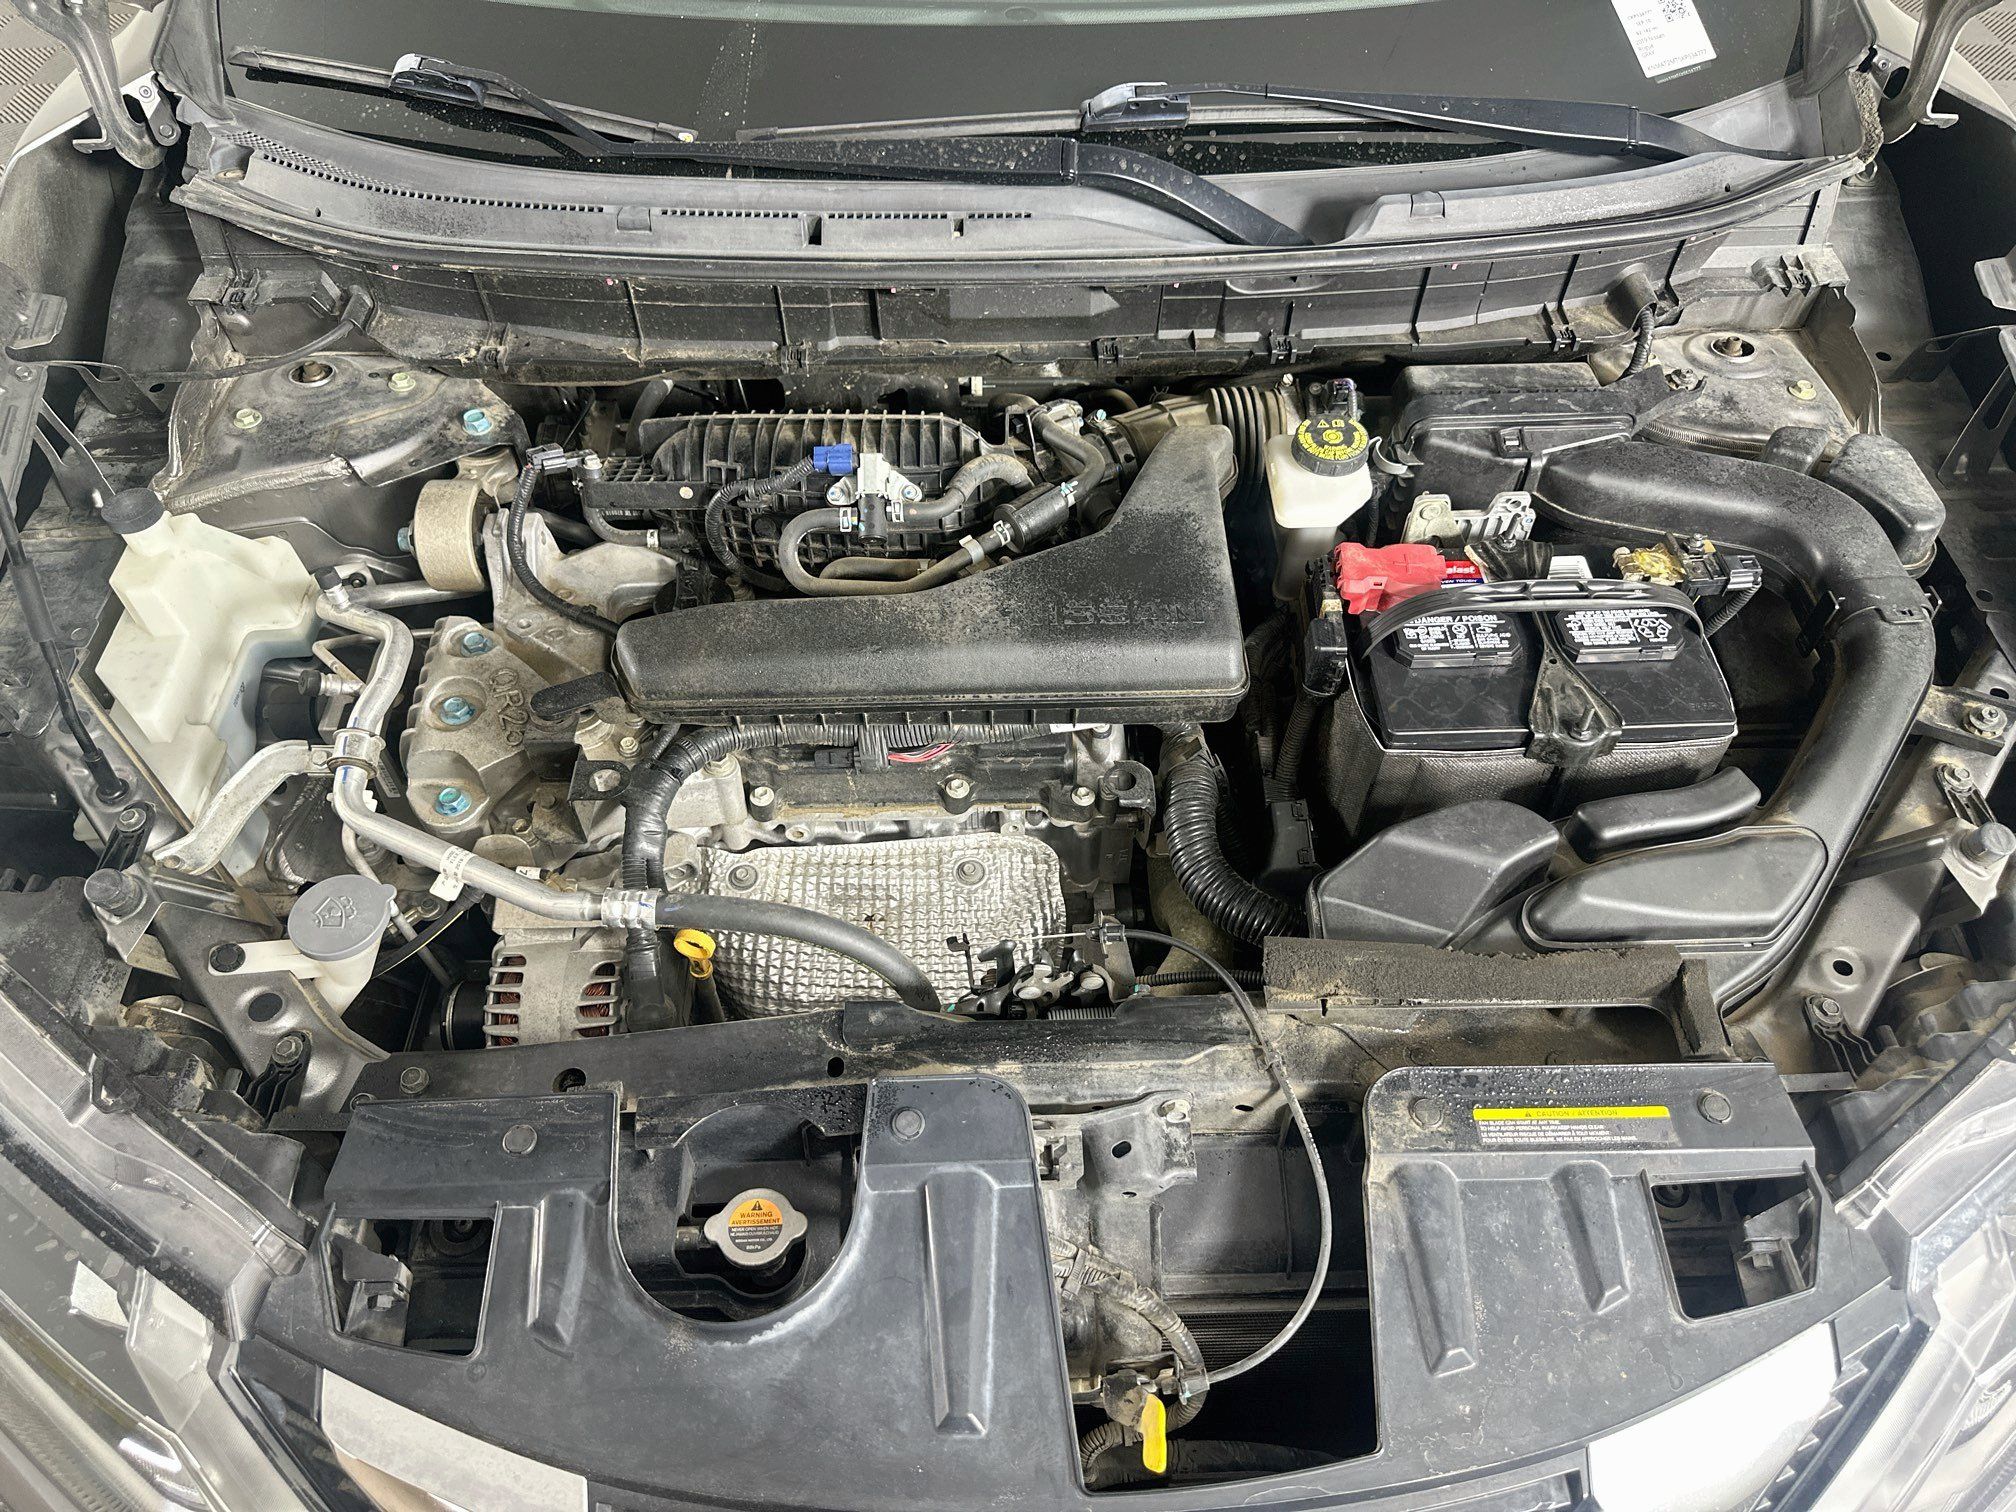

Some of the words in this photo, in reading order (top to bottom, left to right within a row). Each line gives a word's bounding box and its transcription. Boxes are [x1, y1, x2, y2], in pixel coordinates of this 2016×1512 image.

[1414, 616, 1453, 624] DANGER
[1461, 614, 1498, 622] POISON
[740, 1211, 773, 1219] WARNING
